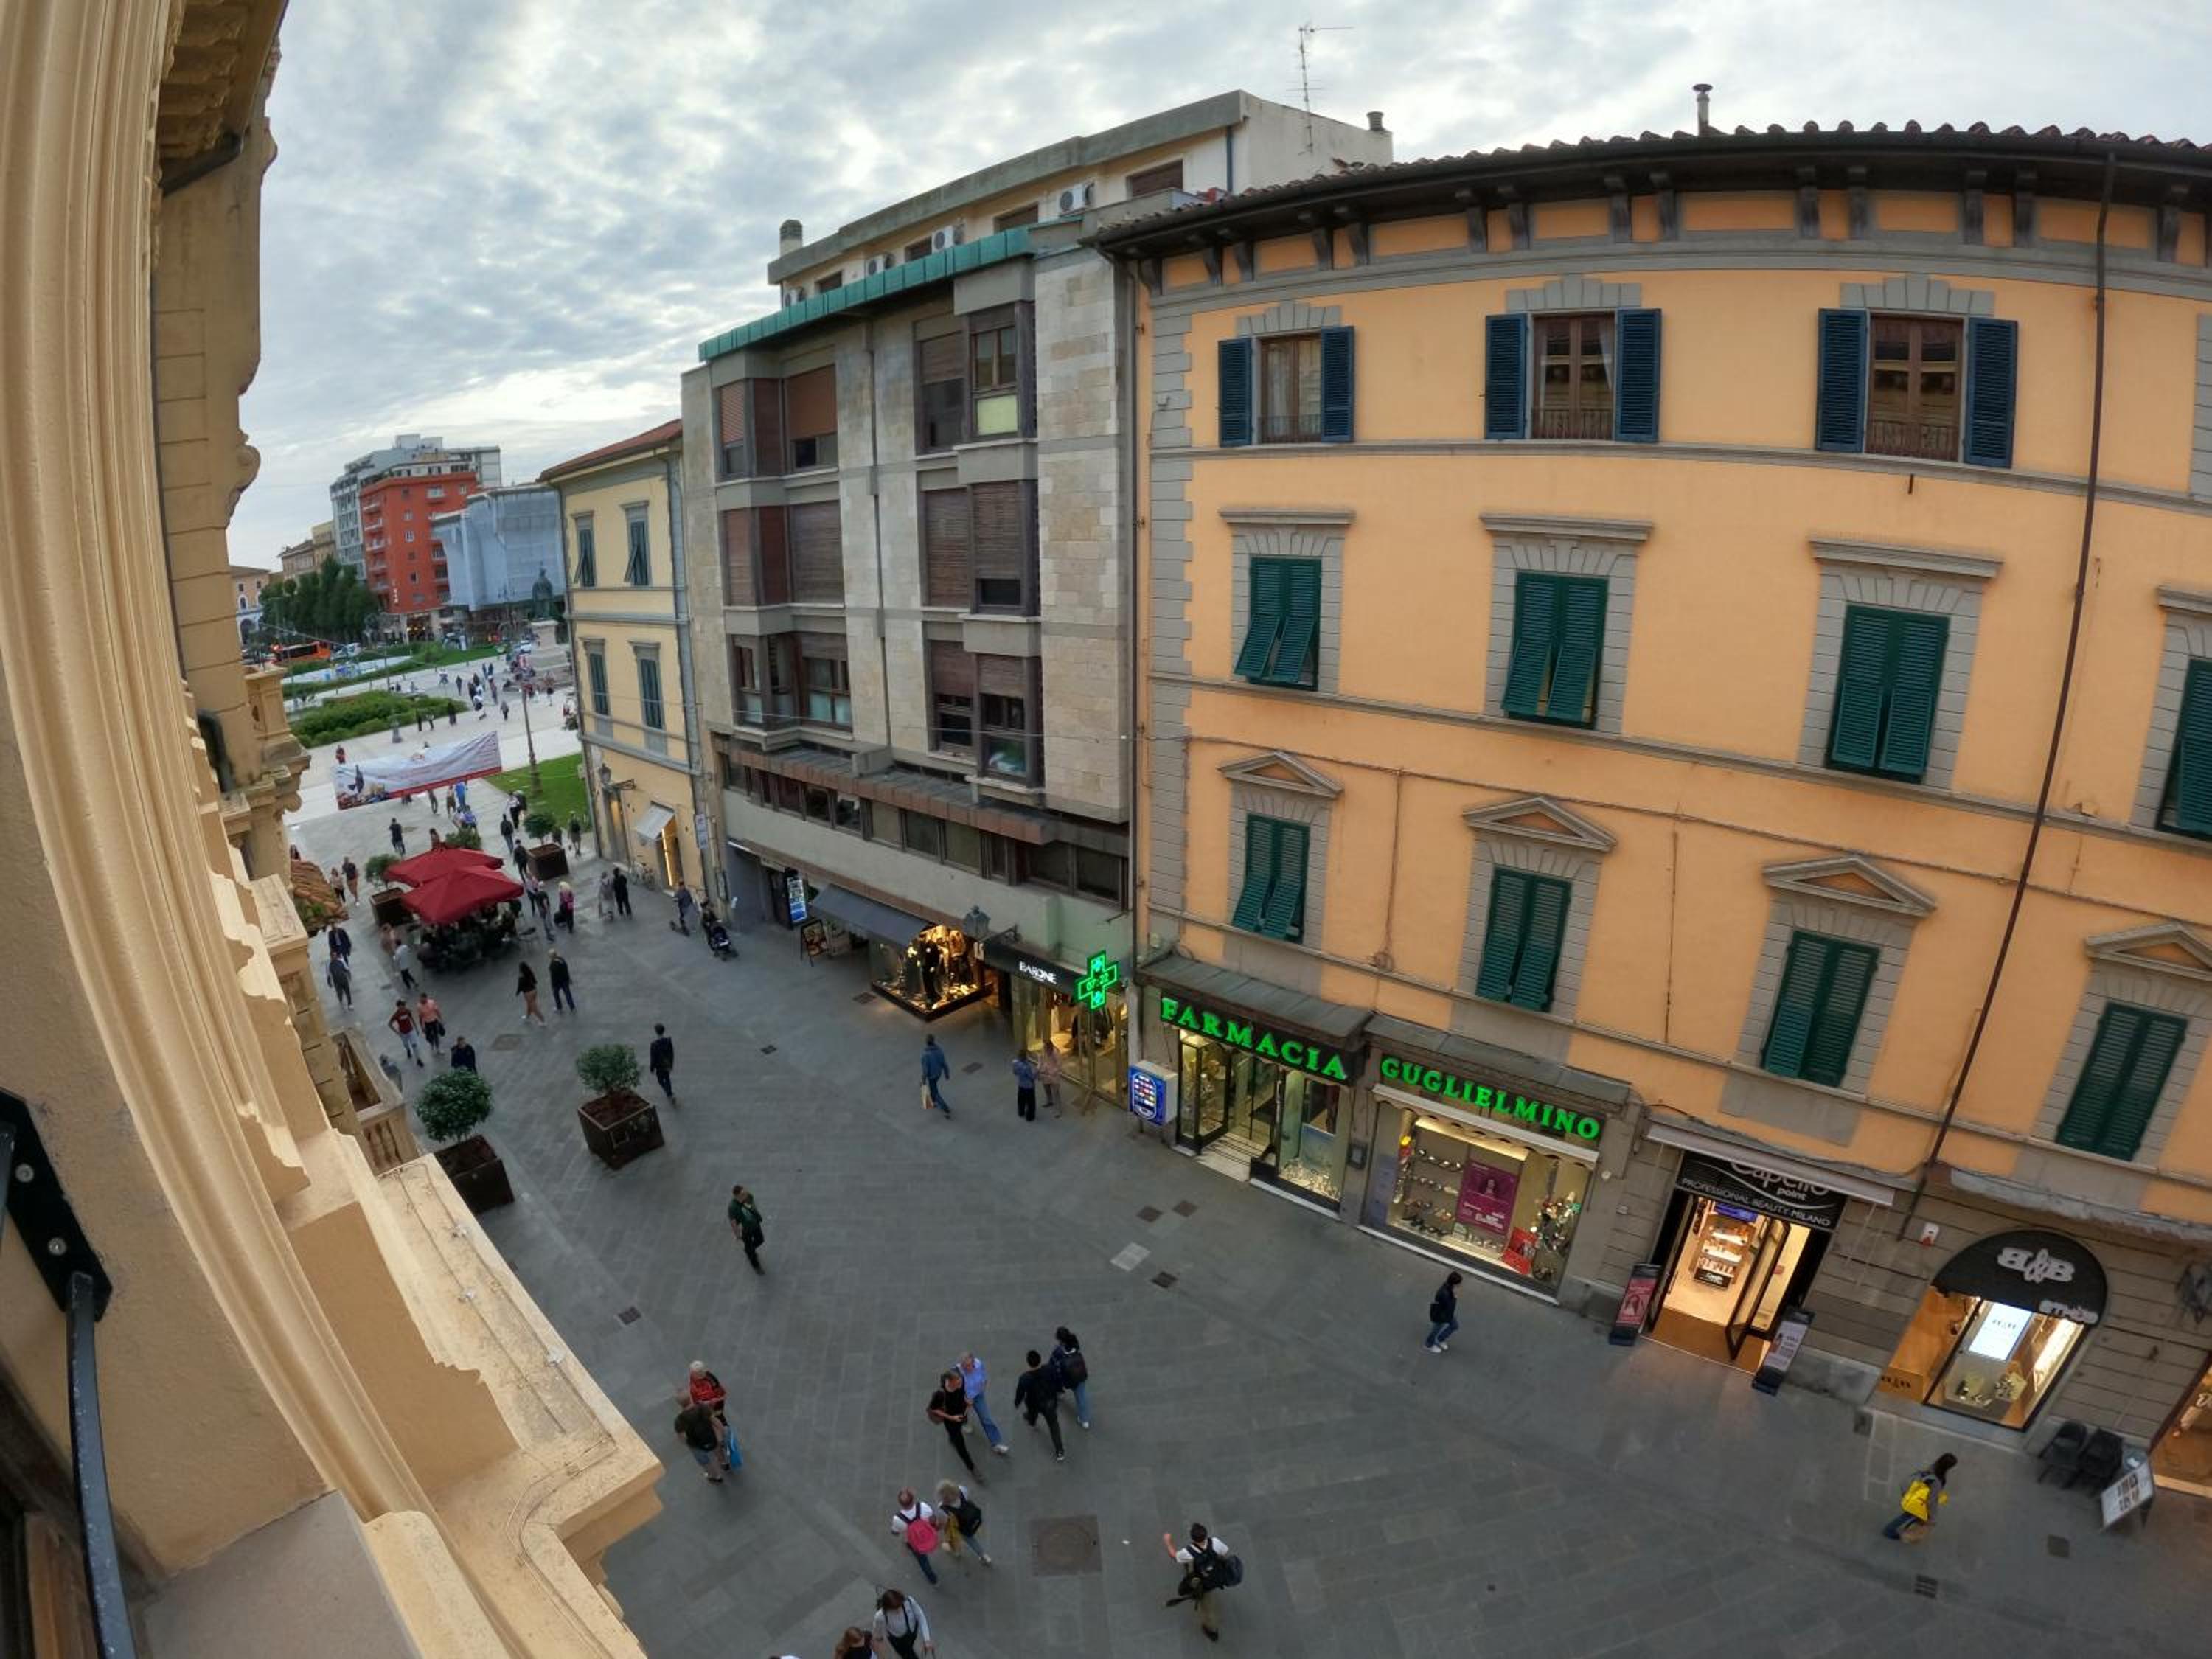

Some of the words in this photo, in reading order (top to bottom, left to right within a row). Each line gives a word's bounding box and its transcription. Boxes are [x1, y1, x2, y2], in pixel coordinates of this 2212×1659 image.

[1020, 961, 1057, 984] BARONE
[1161, 997, 1347, 1080] FARMACIA
[1381, 1056, 1600, 1140] GUGLIELMINO
[1681, 1178, 1750, 1203] PROFESSIONAL
[1790, 1210, 1832, 1227] MILANO
[1776, 1189, 1807, 1201] point
